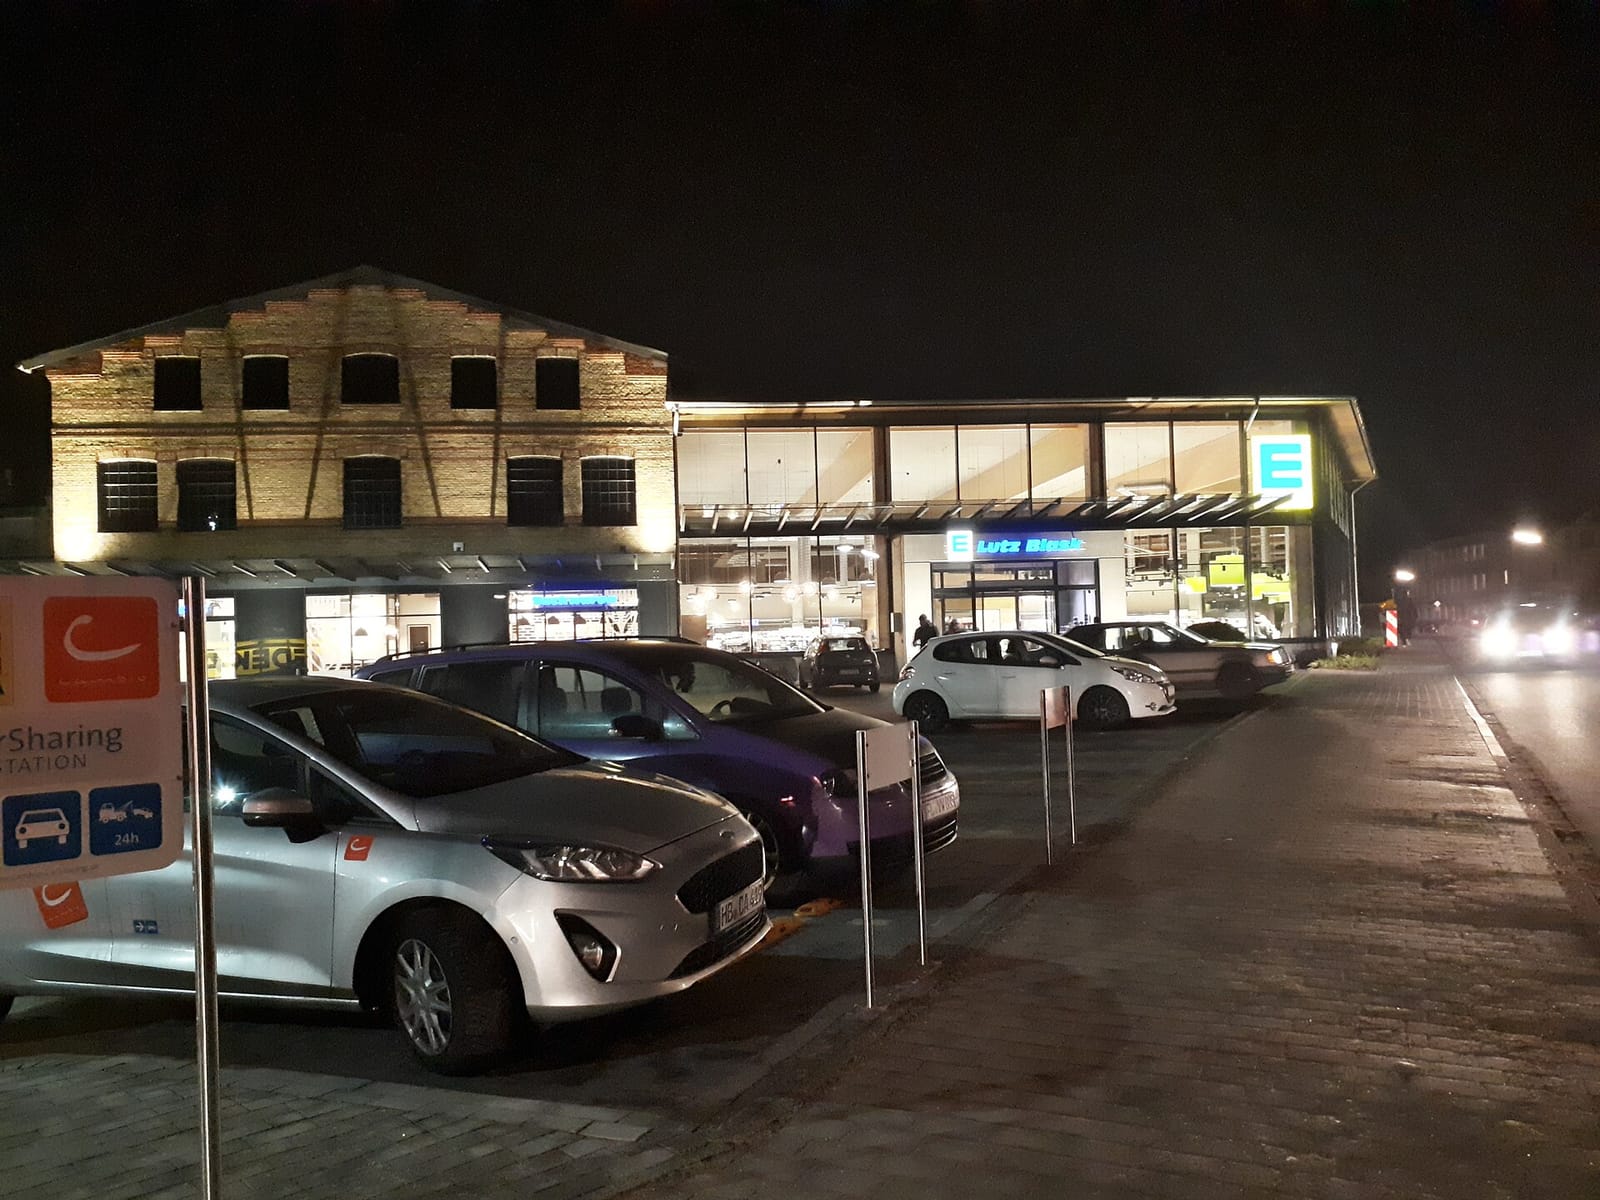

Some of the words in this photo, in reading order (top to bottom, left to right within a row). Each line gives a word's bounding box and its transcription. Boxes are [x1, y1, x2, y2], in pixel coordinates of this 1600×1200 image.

[1259, 443, 1303, 489] E
[976, 540, 1021, 553] Lutz
[0, 753, 87, 774] TATION
[114, 832, 139, 846] 24h
